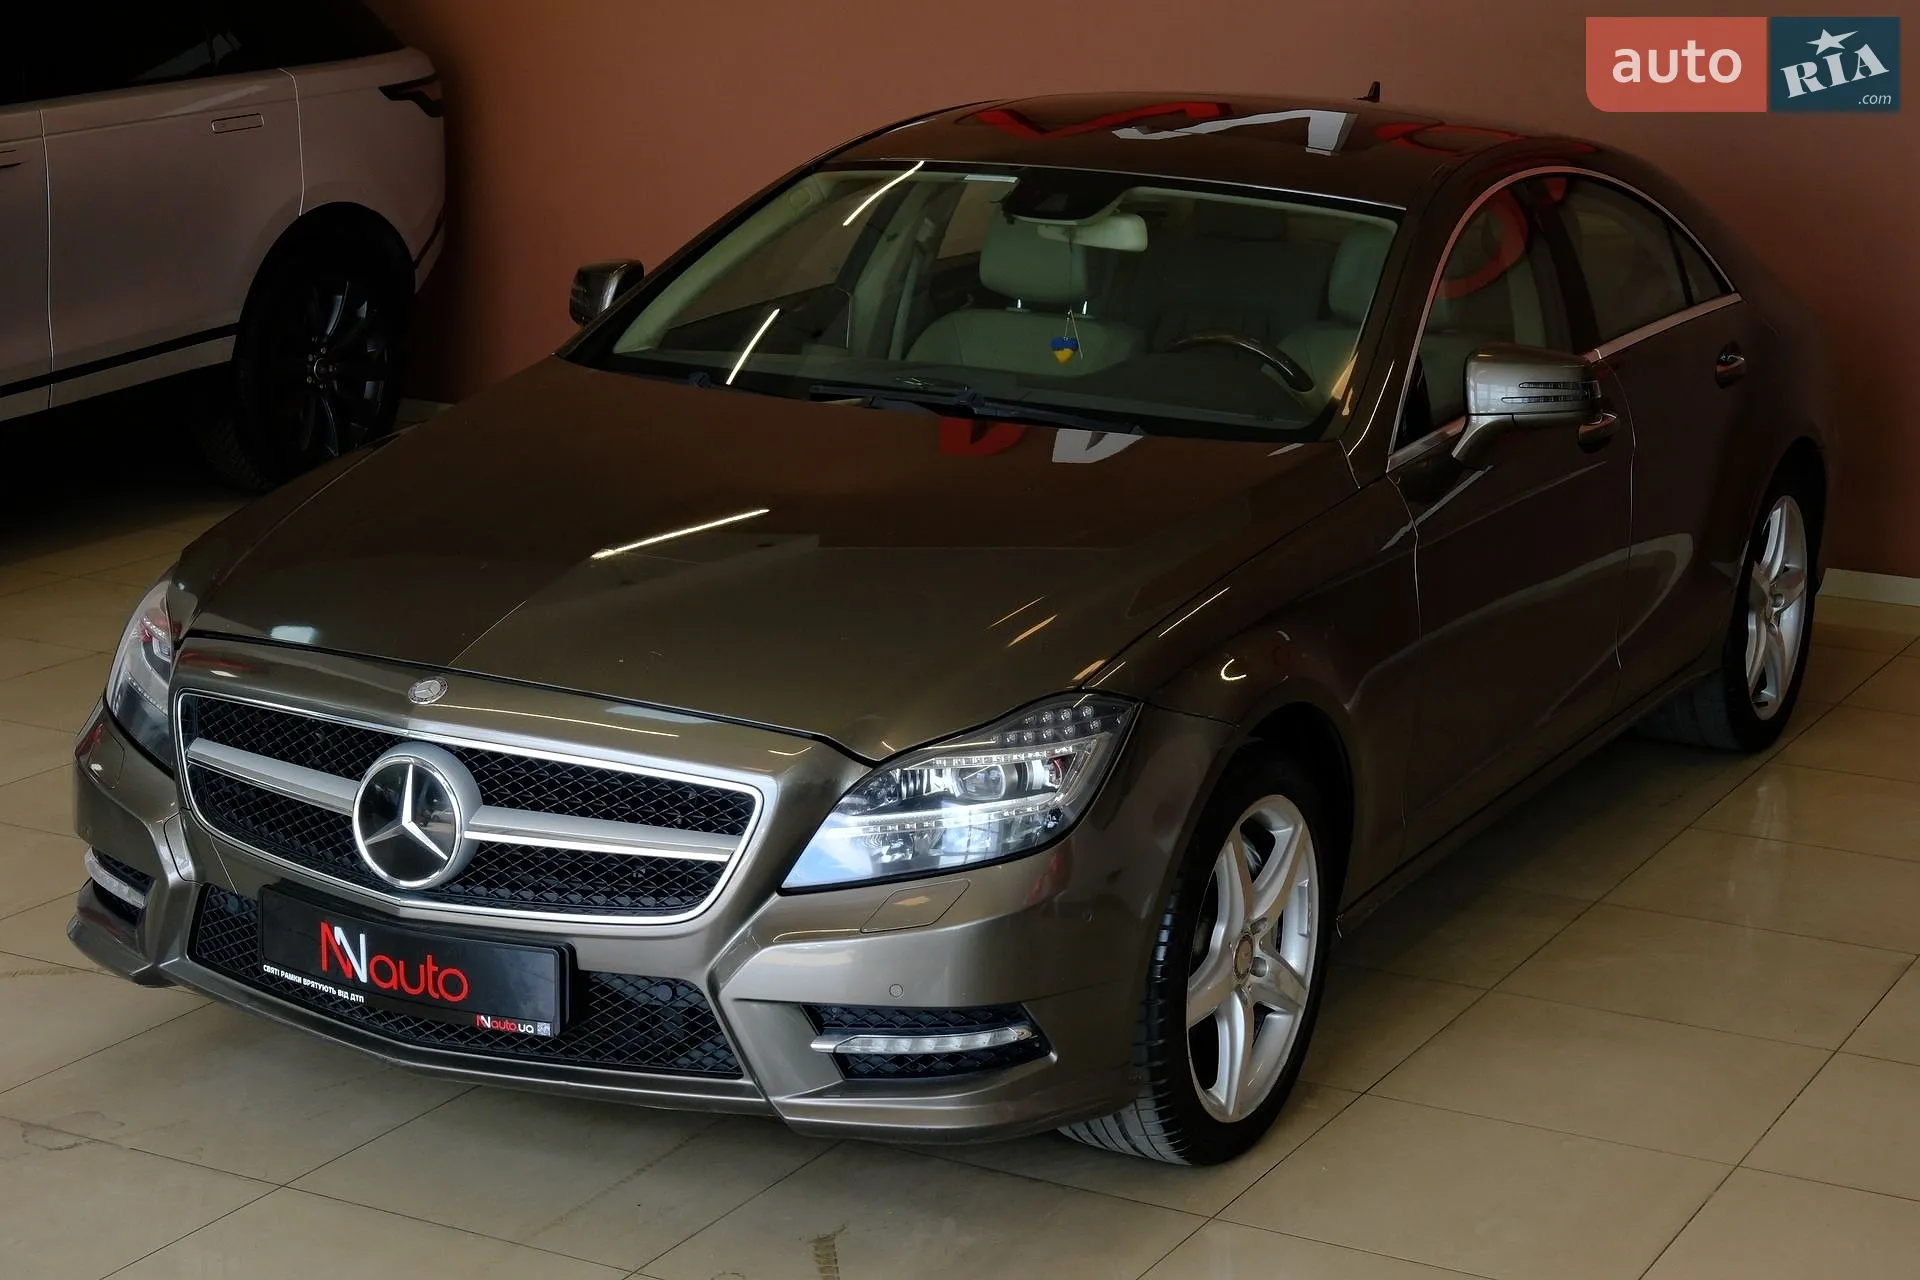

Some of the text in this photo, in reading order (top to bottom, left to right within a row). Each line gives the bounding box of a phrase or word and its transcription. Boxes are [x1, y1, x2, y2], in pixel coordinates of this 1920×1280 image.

[263, 964, 365, 1003] СВЯТІ РАМКИ ВРЯТУЮТЬ ВІД ДТП
